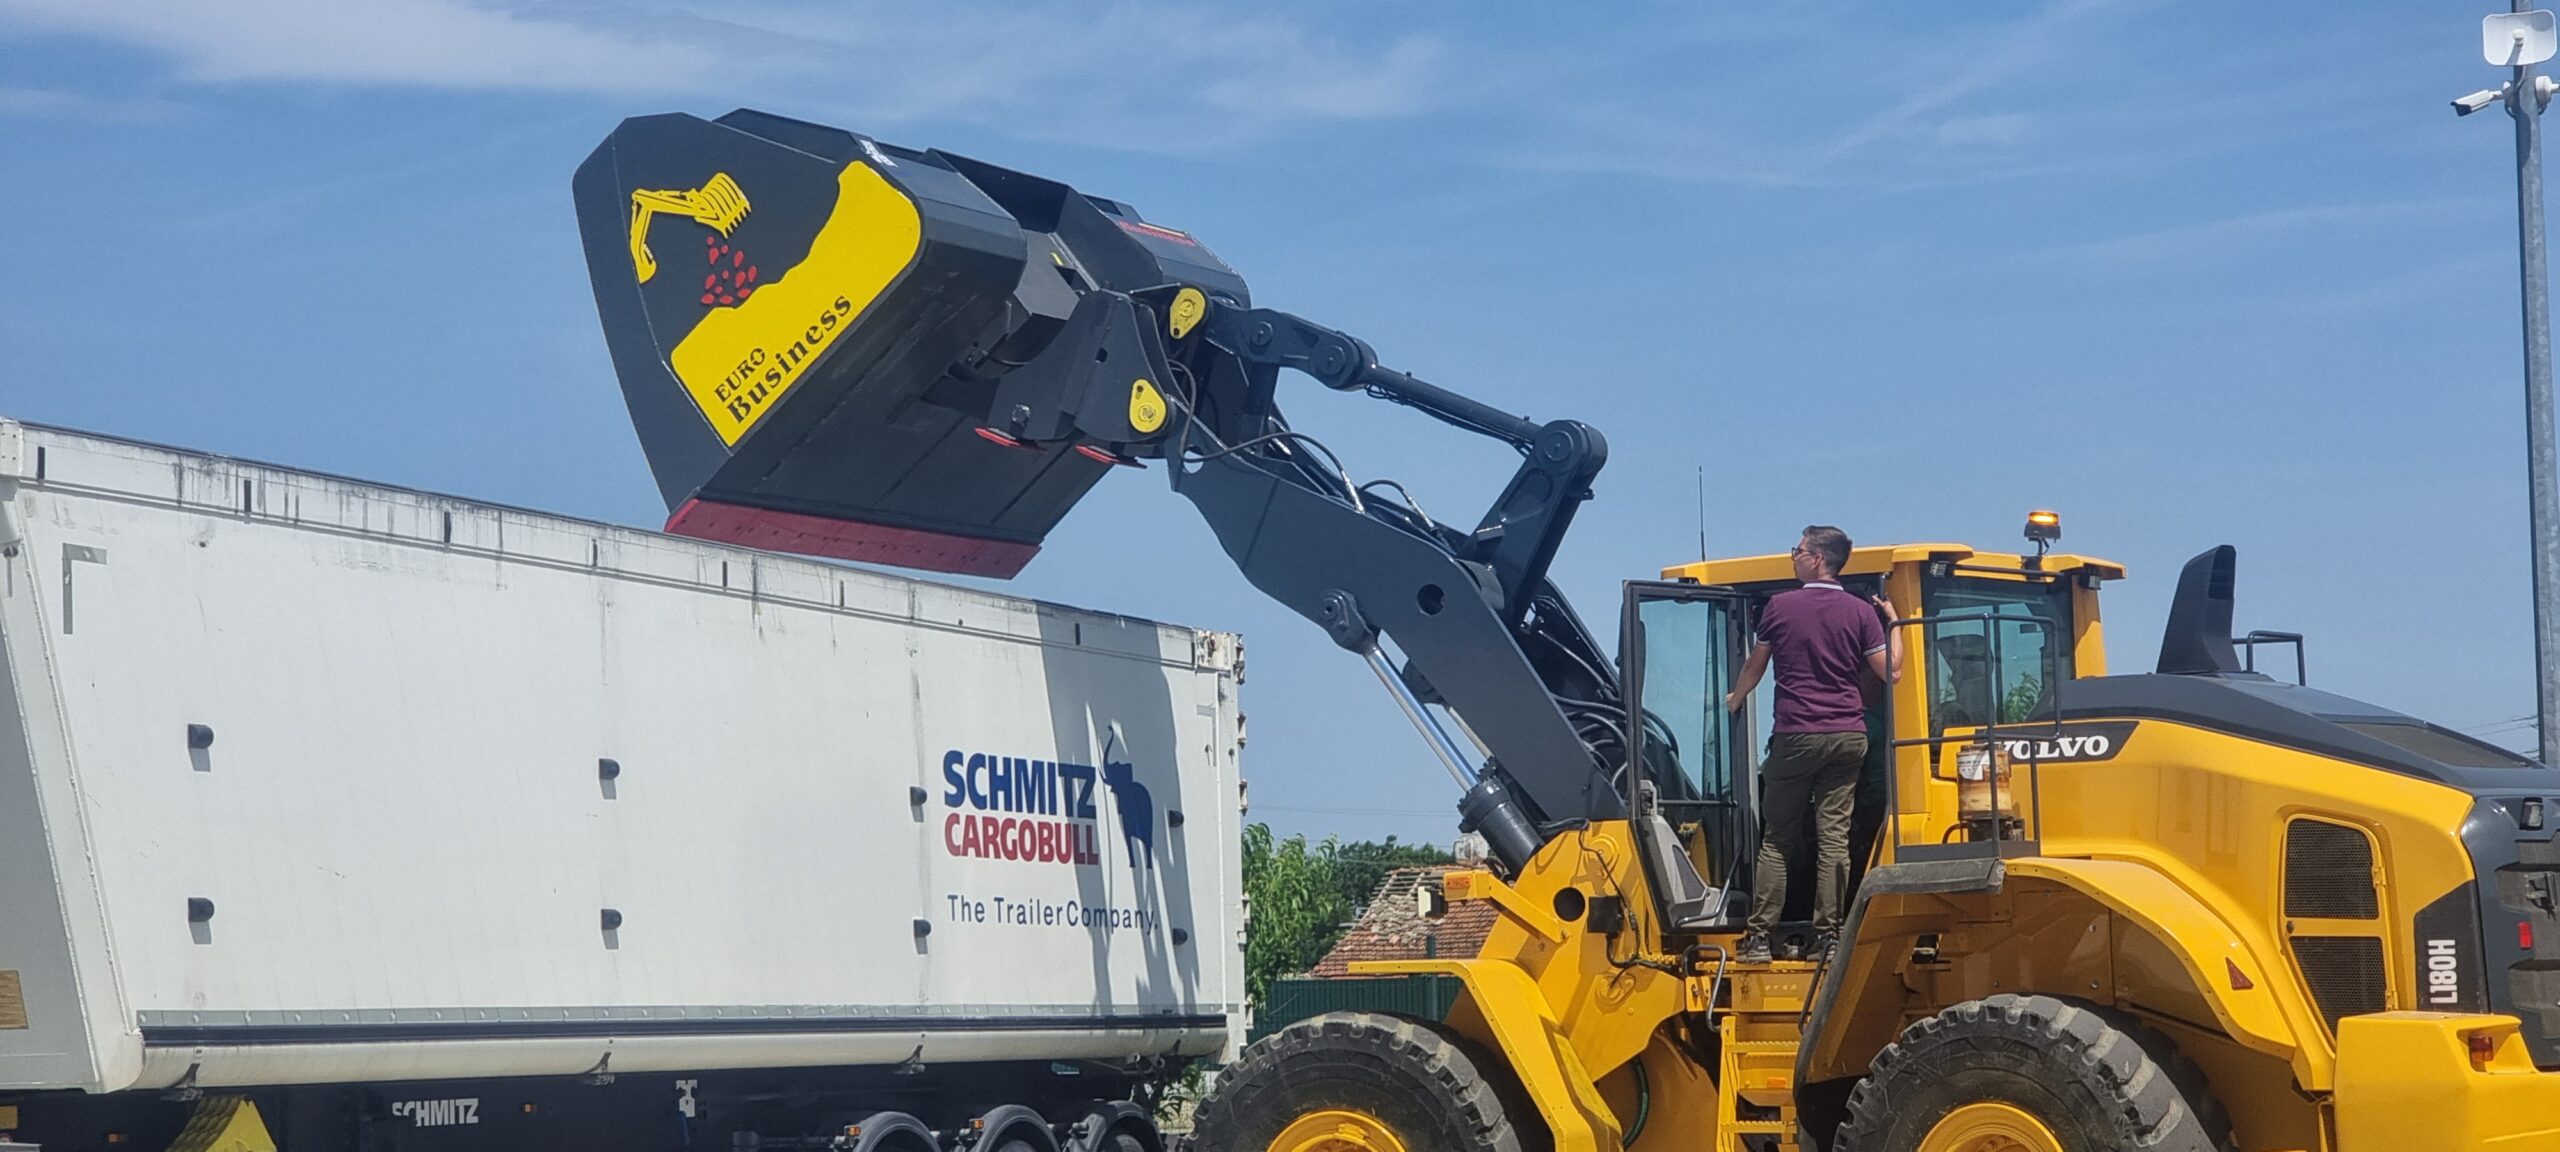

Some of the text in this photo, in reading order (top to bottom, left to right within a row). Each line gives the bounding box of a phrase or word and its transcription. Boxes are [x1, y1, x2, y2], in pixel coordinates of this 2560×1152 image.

[714, 348, 766, 403] EURO
[727, 295, 851, 424] Business
[943, 750, 1097, 819] SCHMITZ
[945, 813, 1099, 865] CARGOBULL
[947, 894, 985, 923] The
[2428, 940, 2458, 1003] L180H
